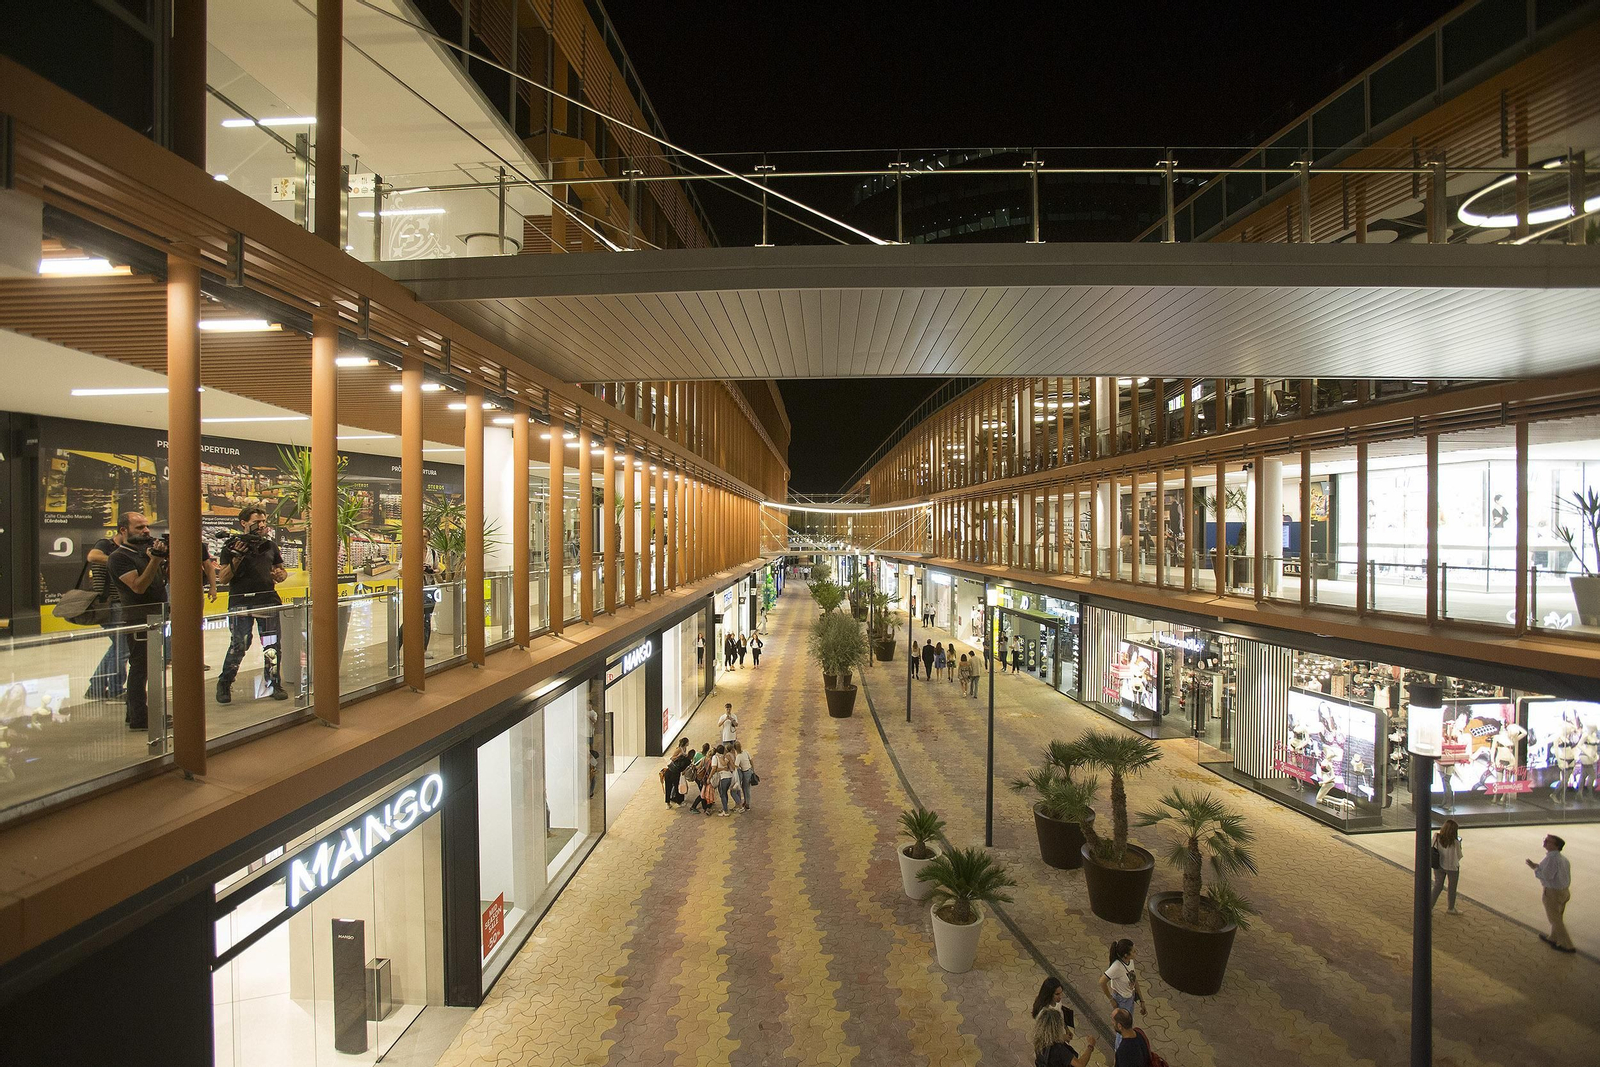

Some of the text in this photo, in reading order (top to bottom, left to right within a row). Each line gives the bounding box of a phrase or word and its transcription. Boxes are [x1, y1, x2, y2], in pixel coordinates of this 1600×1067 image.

[274, 186, 279, 194] 1
[200, 445, 240, 456] APERTURA
[623, 640, 652, 674] MANGO
[290, 773, 444, 908] MANGO
[484, 905, 502, 930] SEASON
[488, 903, 498, 918] MID
[488, 916, 499, 933] SALE
